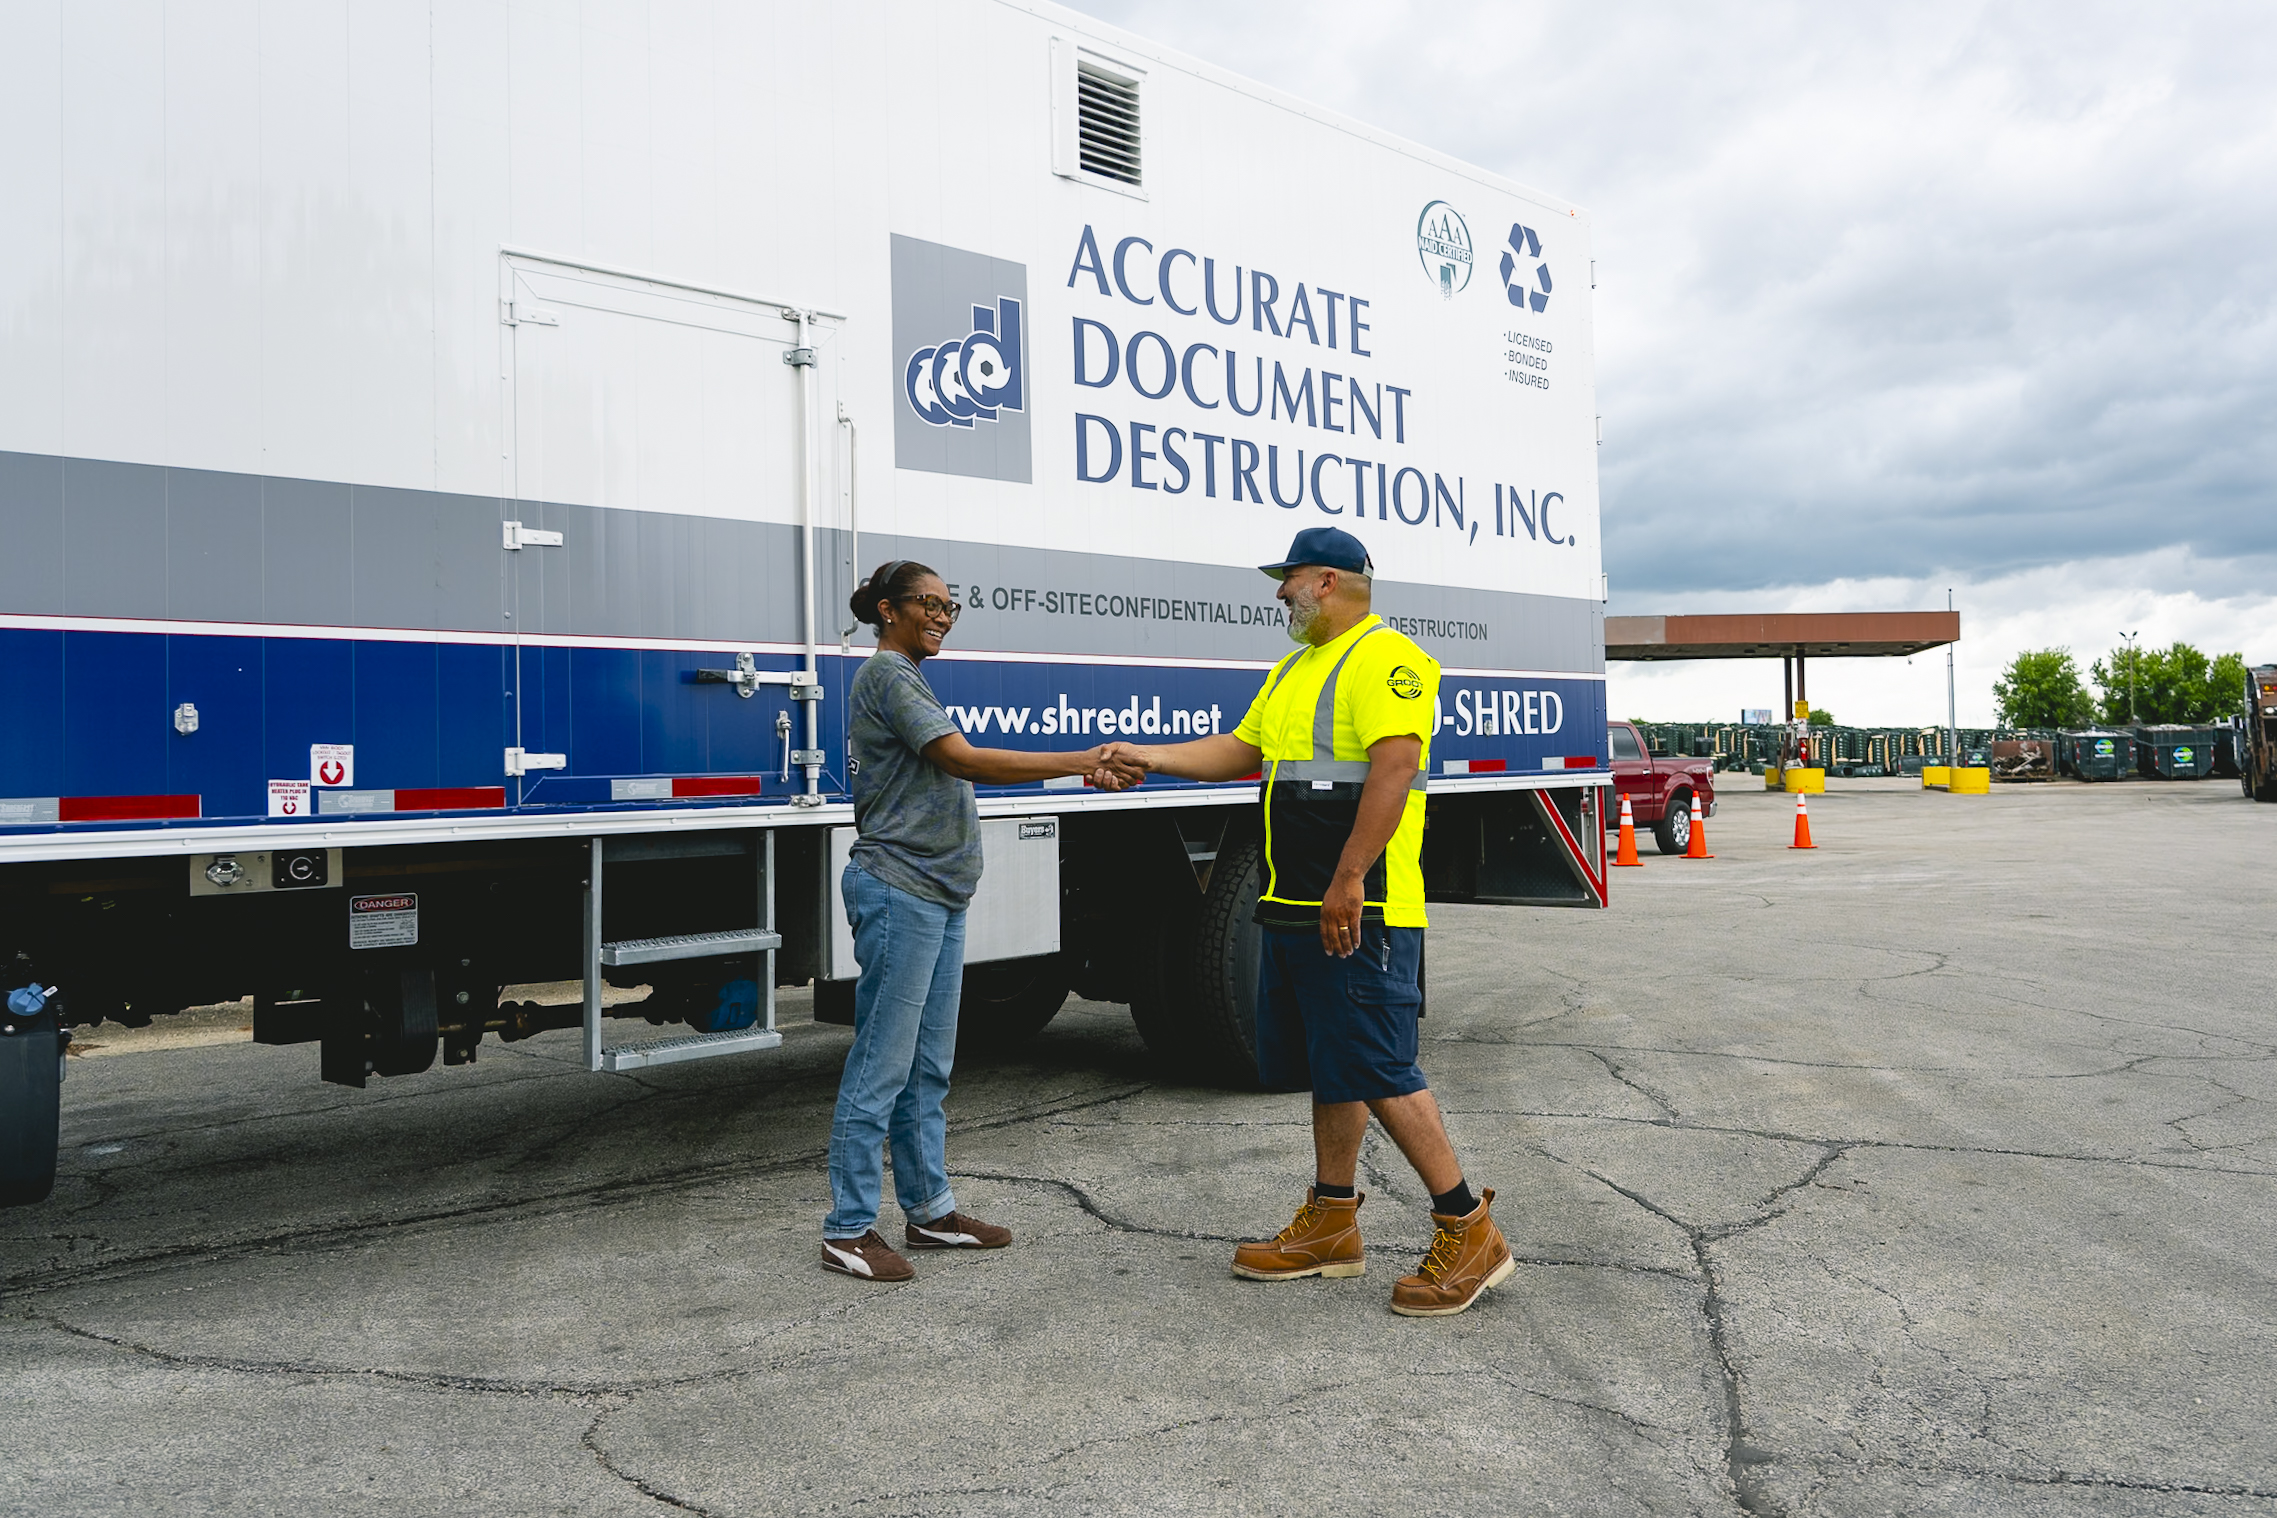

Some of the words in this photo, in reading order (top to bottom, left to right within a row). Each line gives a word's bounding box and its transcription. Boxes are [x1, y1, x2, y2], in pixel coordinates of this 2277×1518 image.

[1428, 213, 1463, 247] AAA
[1418, 236, 1439, 255] NAID
[1438, 241, 1473, 264] CERTIFIED
[1066, 223, 1371, 358] ACCURATE
[1507, 330, 1553, 354] LICENSED
[1508, 349, 1548, 371] BONDED
[1072, 316, 1412, 445] DOCUMENT
[1508, 369, 1550, 390] INSURED
[1074, 412, 1479, 547] DESTRUCTION,
[1494, 482, 1576, 547] INC.
[968, 585, 985, 609] &
[1240, 604, 1286, 628] DATA
[1389, 616, 1488, 641] DESTRUCTION
[944, 693, 1222, 736] ww.shredd.net
[360, 899, 409, 910] DANGER
